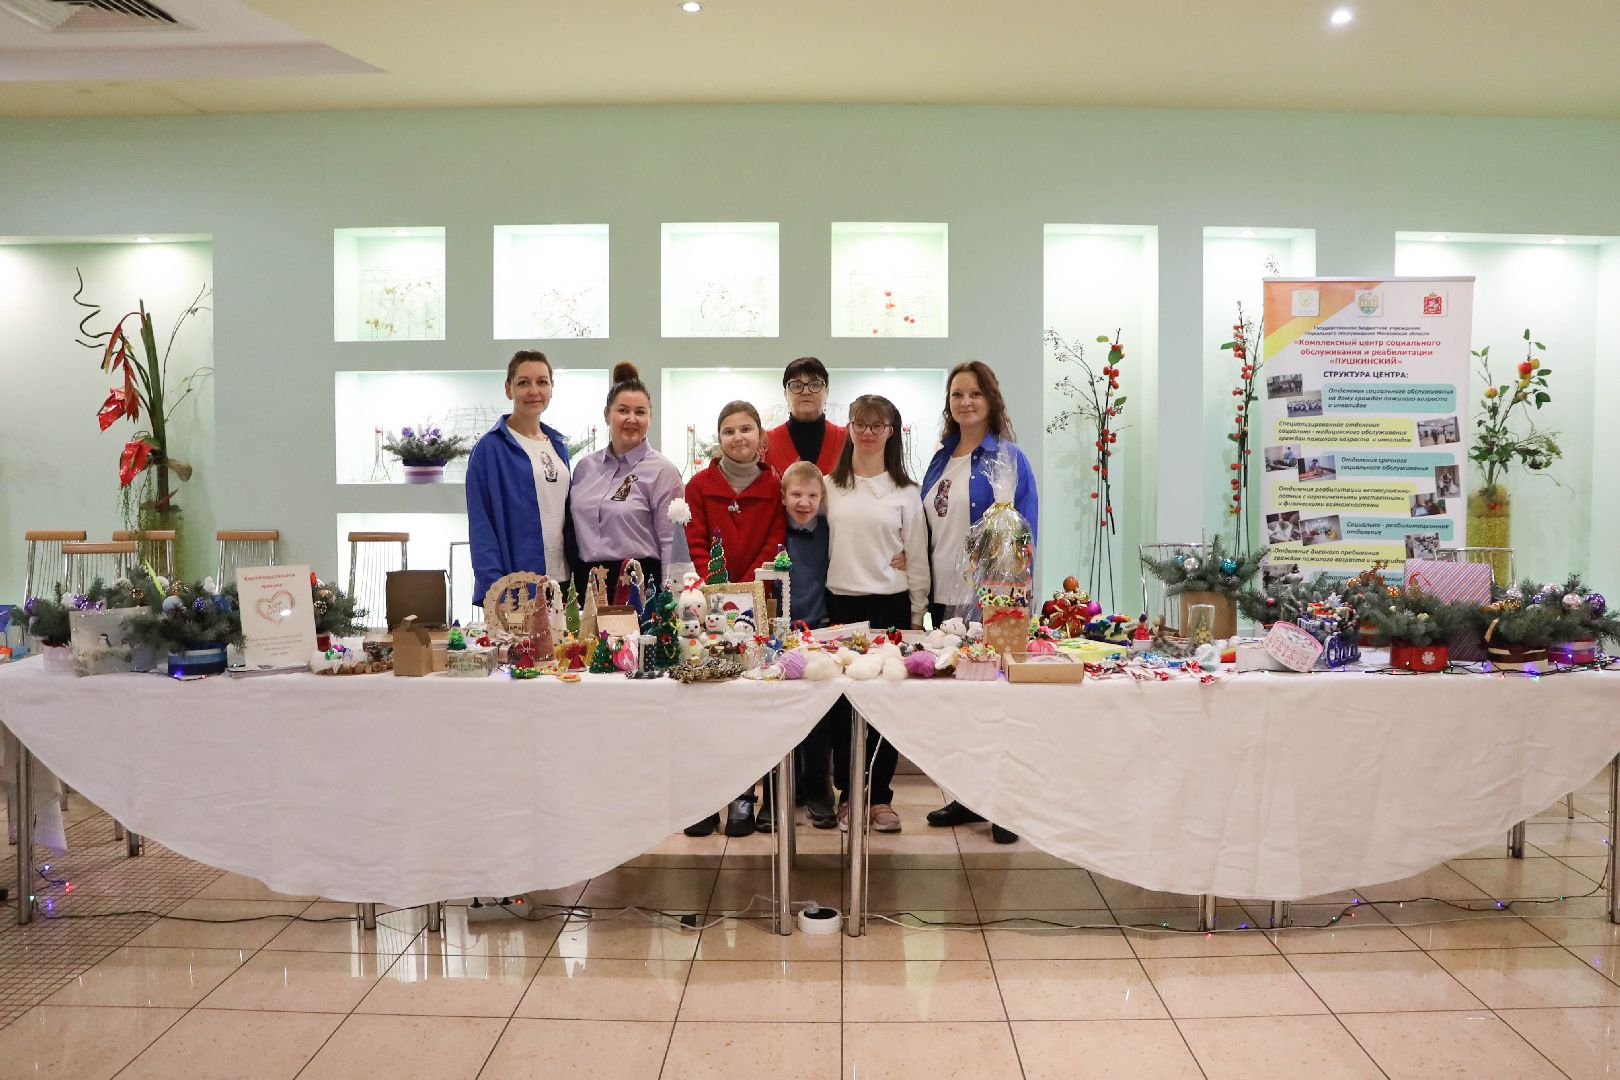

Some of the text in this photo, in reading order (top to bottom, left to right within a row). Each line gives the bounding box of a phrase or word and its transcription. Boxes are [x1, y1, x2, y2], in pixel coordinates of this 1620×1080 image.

[1294, 338, 1441, 348] «Комплексный центр социального
[1300, 348, 1362, 357] обслуживания
[1371, 349, 1433, 357] реабилитации
[1329, 356, 1403, 365] «ПУШКИНСКИЙ»
[1323, 371, 1409, 380] СТРУКТУРА ЦЕНТРА:
[1278, 420, 1344, 428] Специализированное
[1315, 486, 1362, 494] реабилитации
[1283, 500, 1325, 508] физическими
[1340, 548, 1380, 556] пребывания
